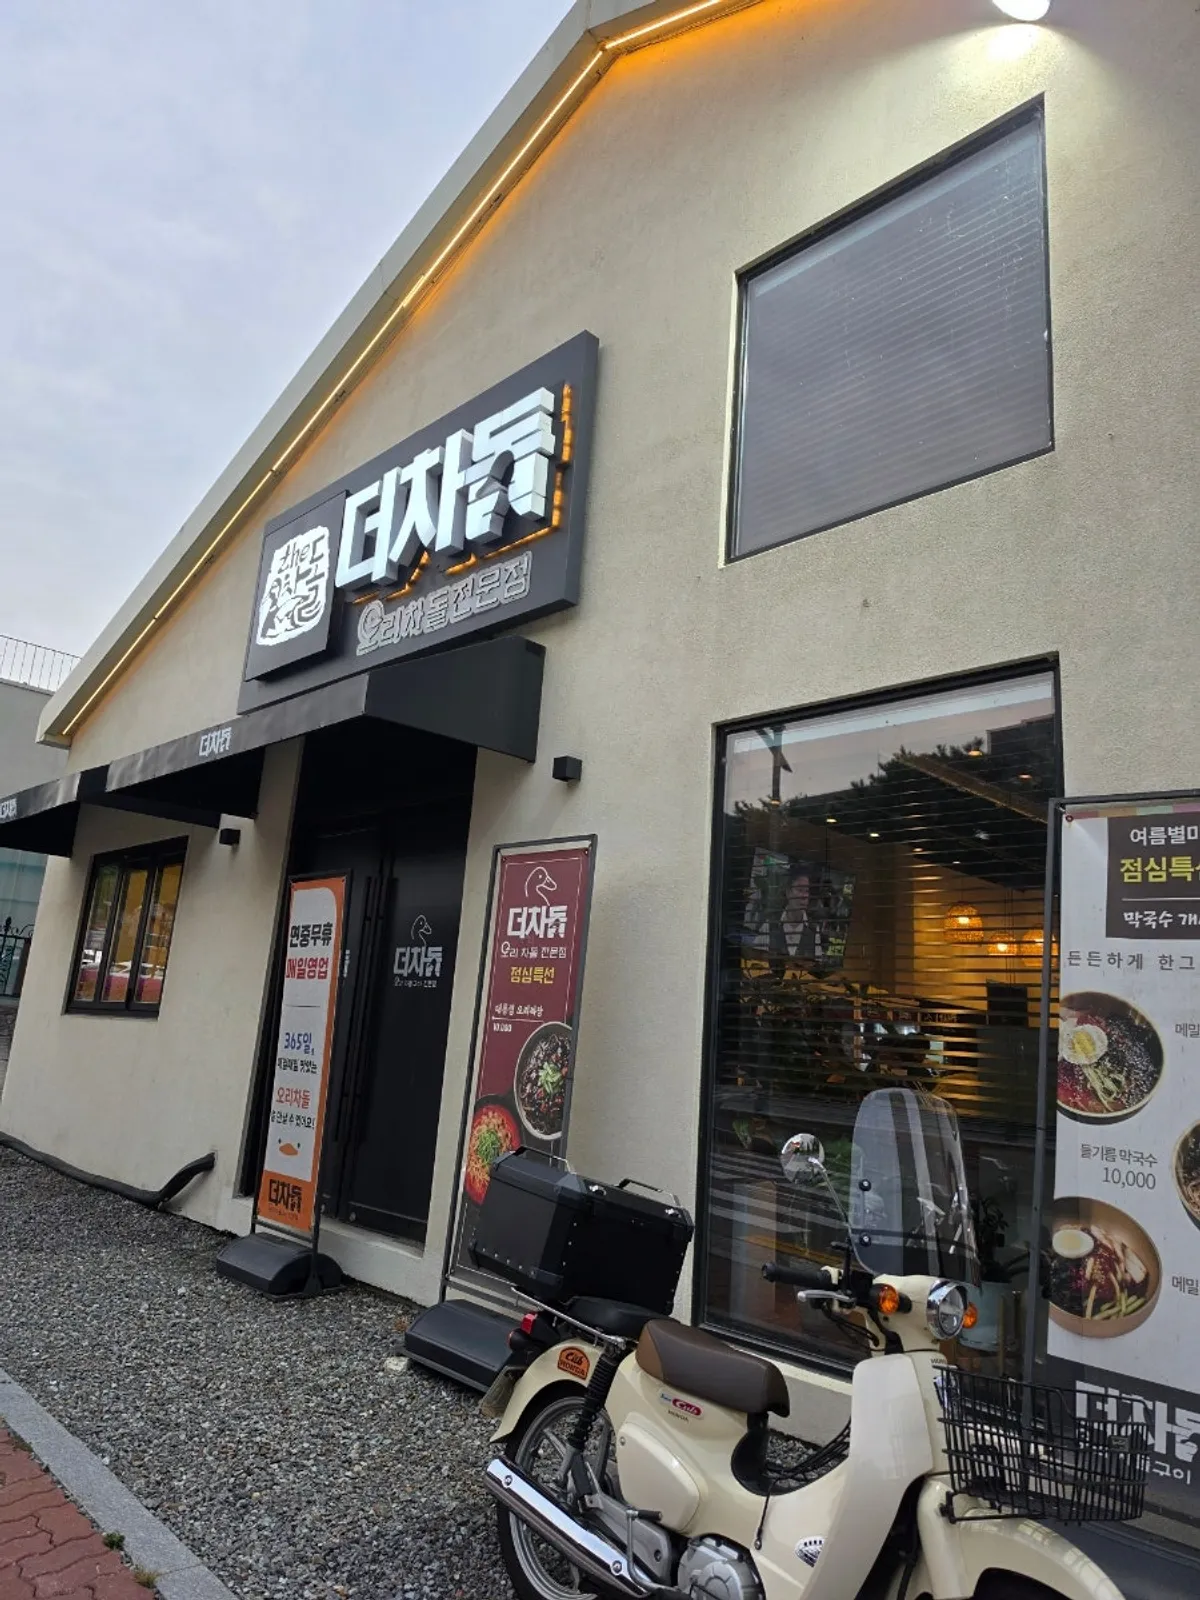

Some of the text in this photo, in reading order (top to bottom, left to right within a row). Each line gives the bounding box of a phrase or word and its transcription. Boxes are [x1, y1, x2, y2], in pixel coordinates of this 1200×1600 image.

[1120, 856, 1200, 883] 점심특
[1123, 911, 1200, 929] 막국수 개
[289, 922, 333, 948] 연중무휴
[500, 941, 519, 958] 오리
[286, 957, 329, 979] 매일영업
[1067, 950, 1196, 971] 든든하게 한그
[511, 966, 555, 984] 점심특선
[276, 1087, 310, 1109] 오리차돌
[1081, 1143, 1158, 1168] 들기름 막국수
[1102, 1166, 1156, 1190] 10,000
[1171, 1276, 1199, 1296] 메밀
[560, 1360, 585, 1376] HONDA
